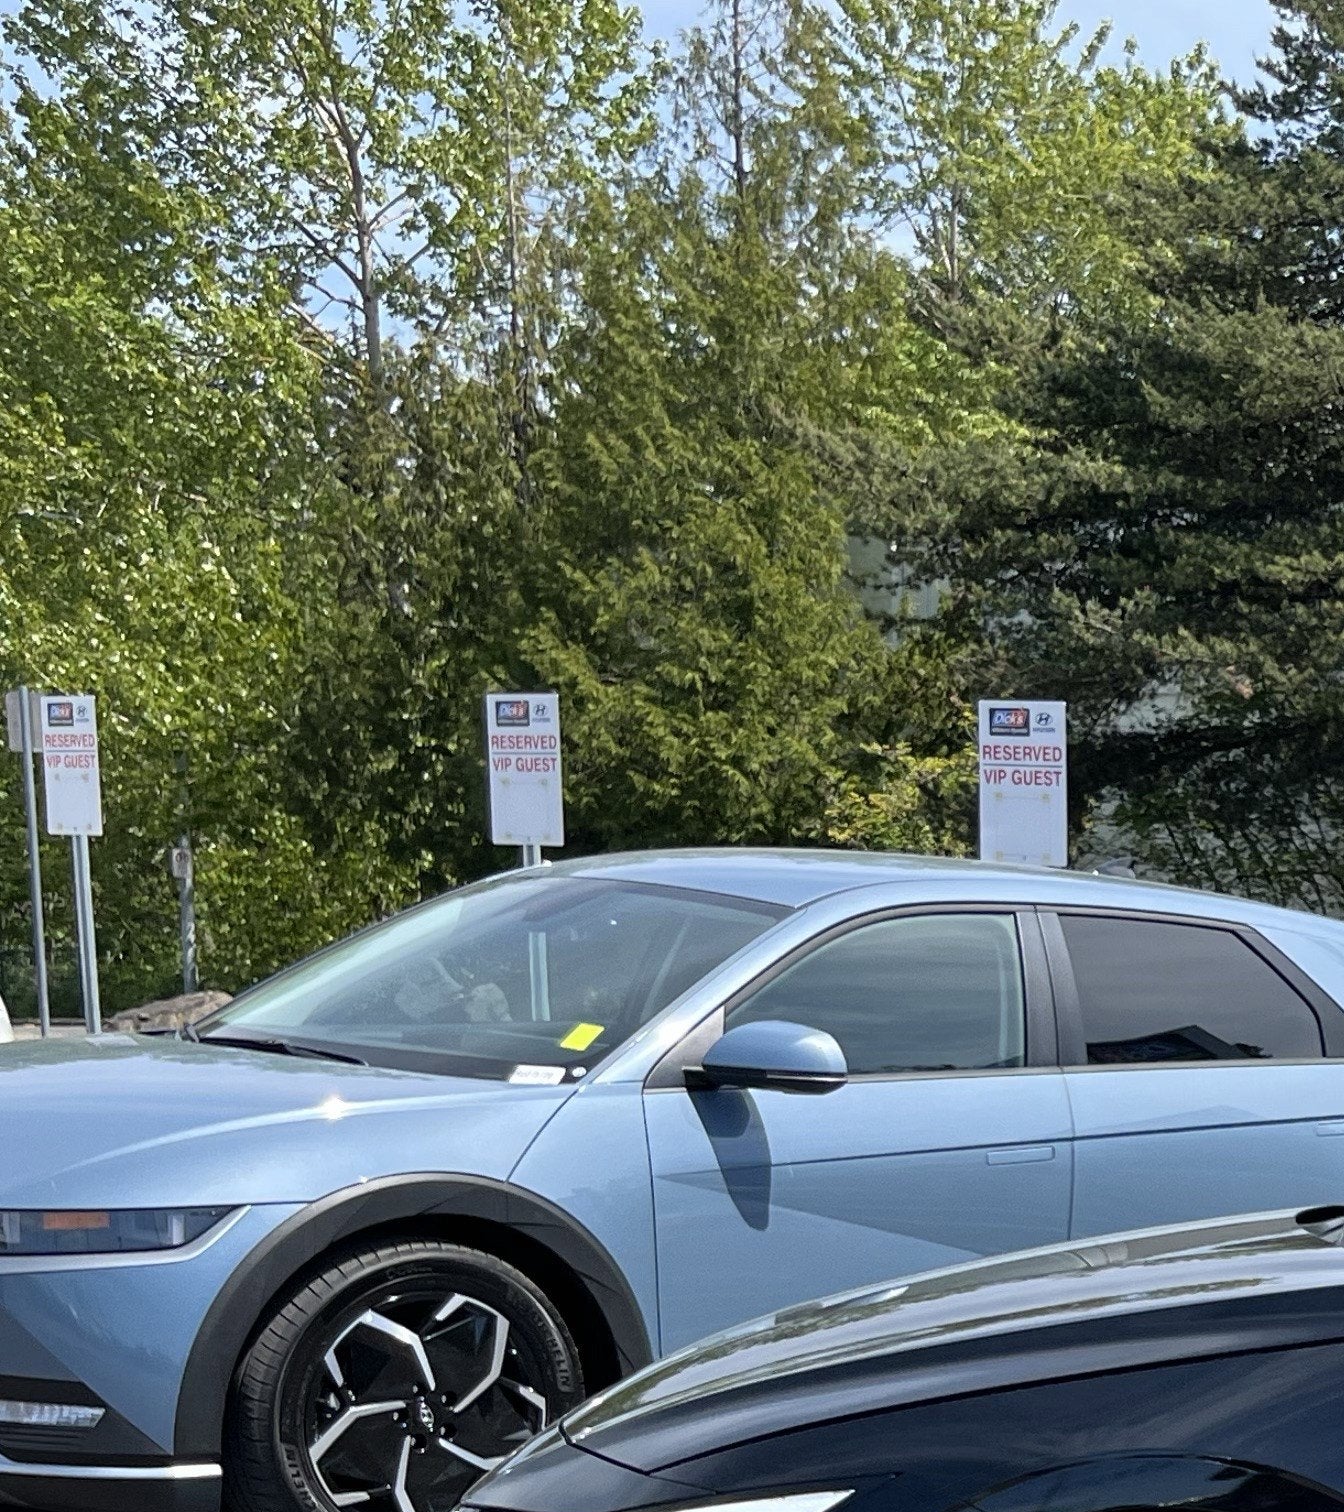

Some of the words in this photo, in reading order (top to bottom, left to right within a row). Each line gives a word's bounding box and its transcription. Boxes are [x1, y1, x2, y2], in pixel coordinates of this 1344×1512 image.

[45, 734, 95, 747] RESERVED
[491, 735, 557, 749] RESERVED
[982, 745, 1062, 762] RESERVED
[47, 755, 61, 768] VIP
[64, 754, 95, 768] GUEST
[492, 757, 512, 771] VIP
[515, 757, 557, 772] GUEST
[983, 769, 1007, 784] VIP
[1011, 769, 1062, 786] GUEST
